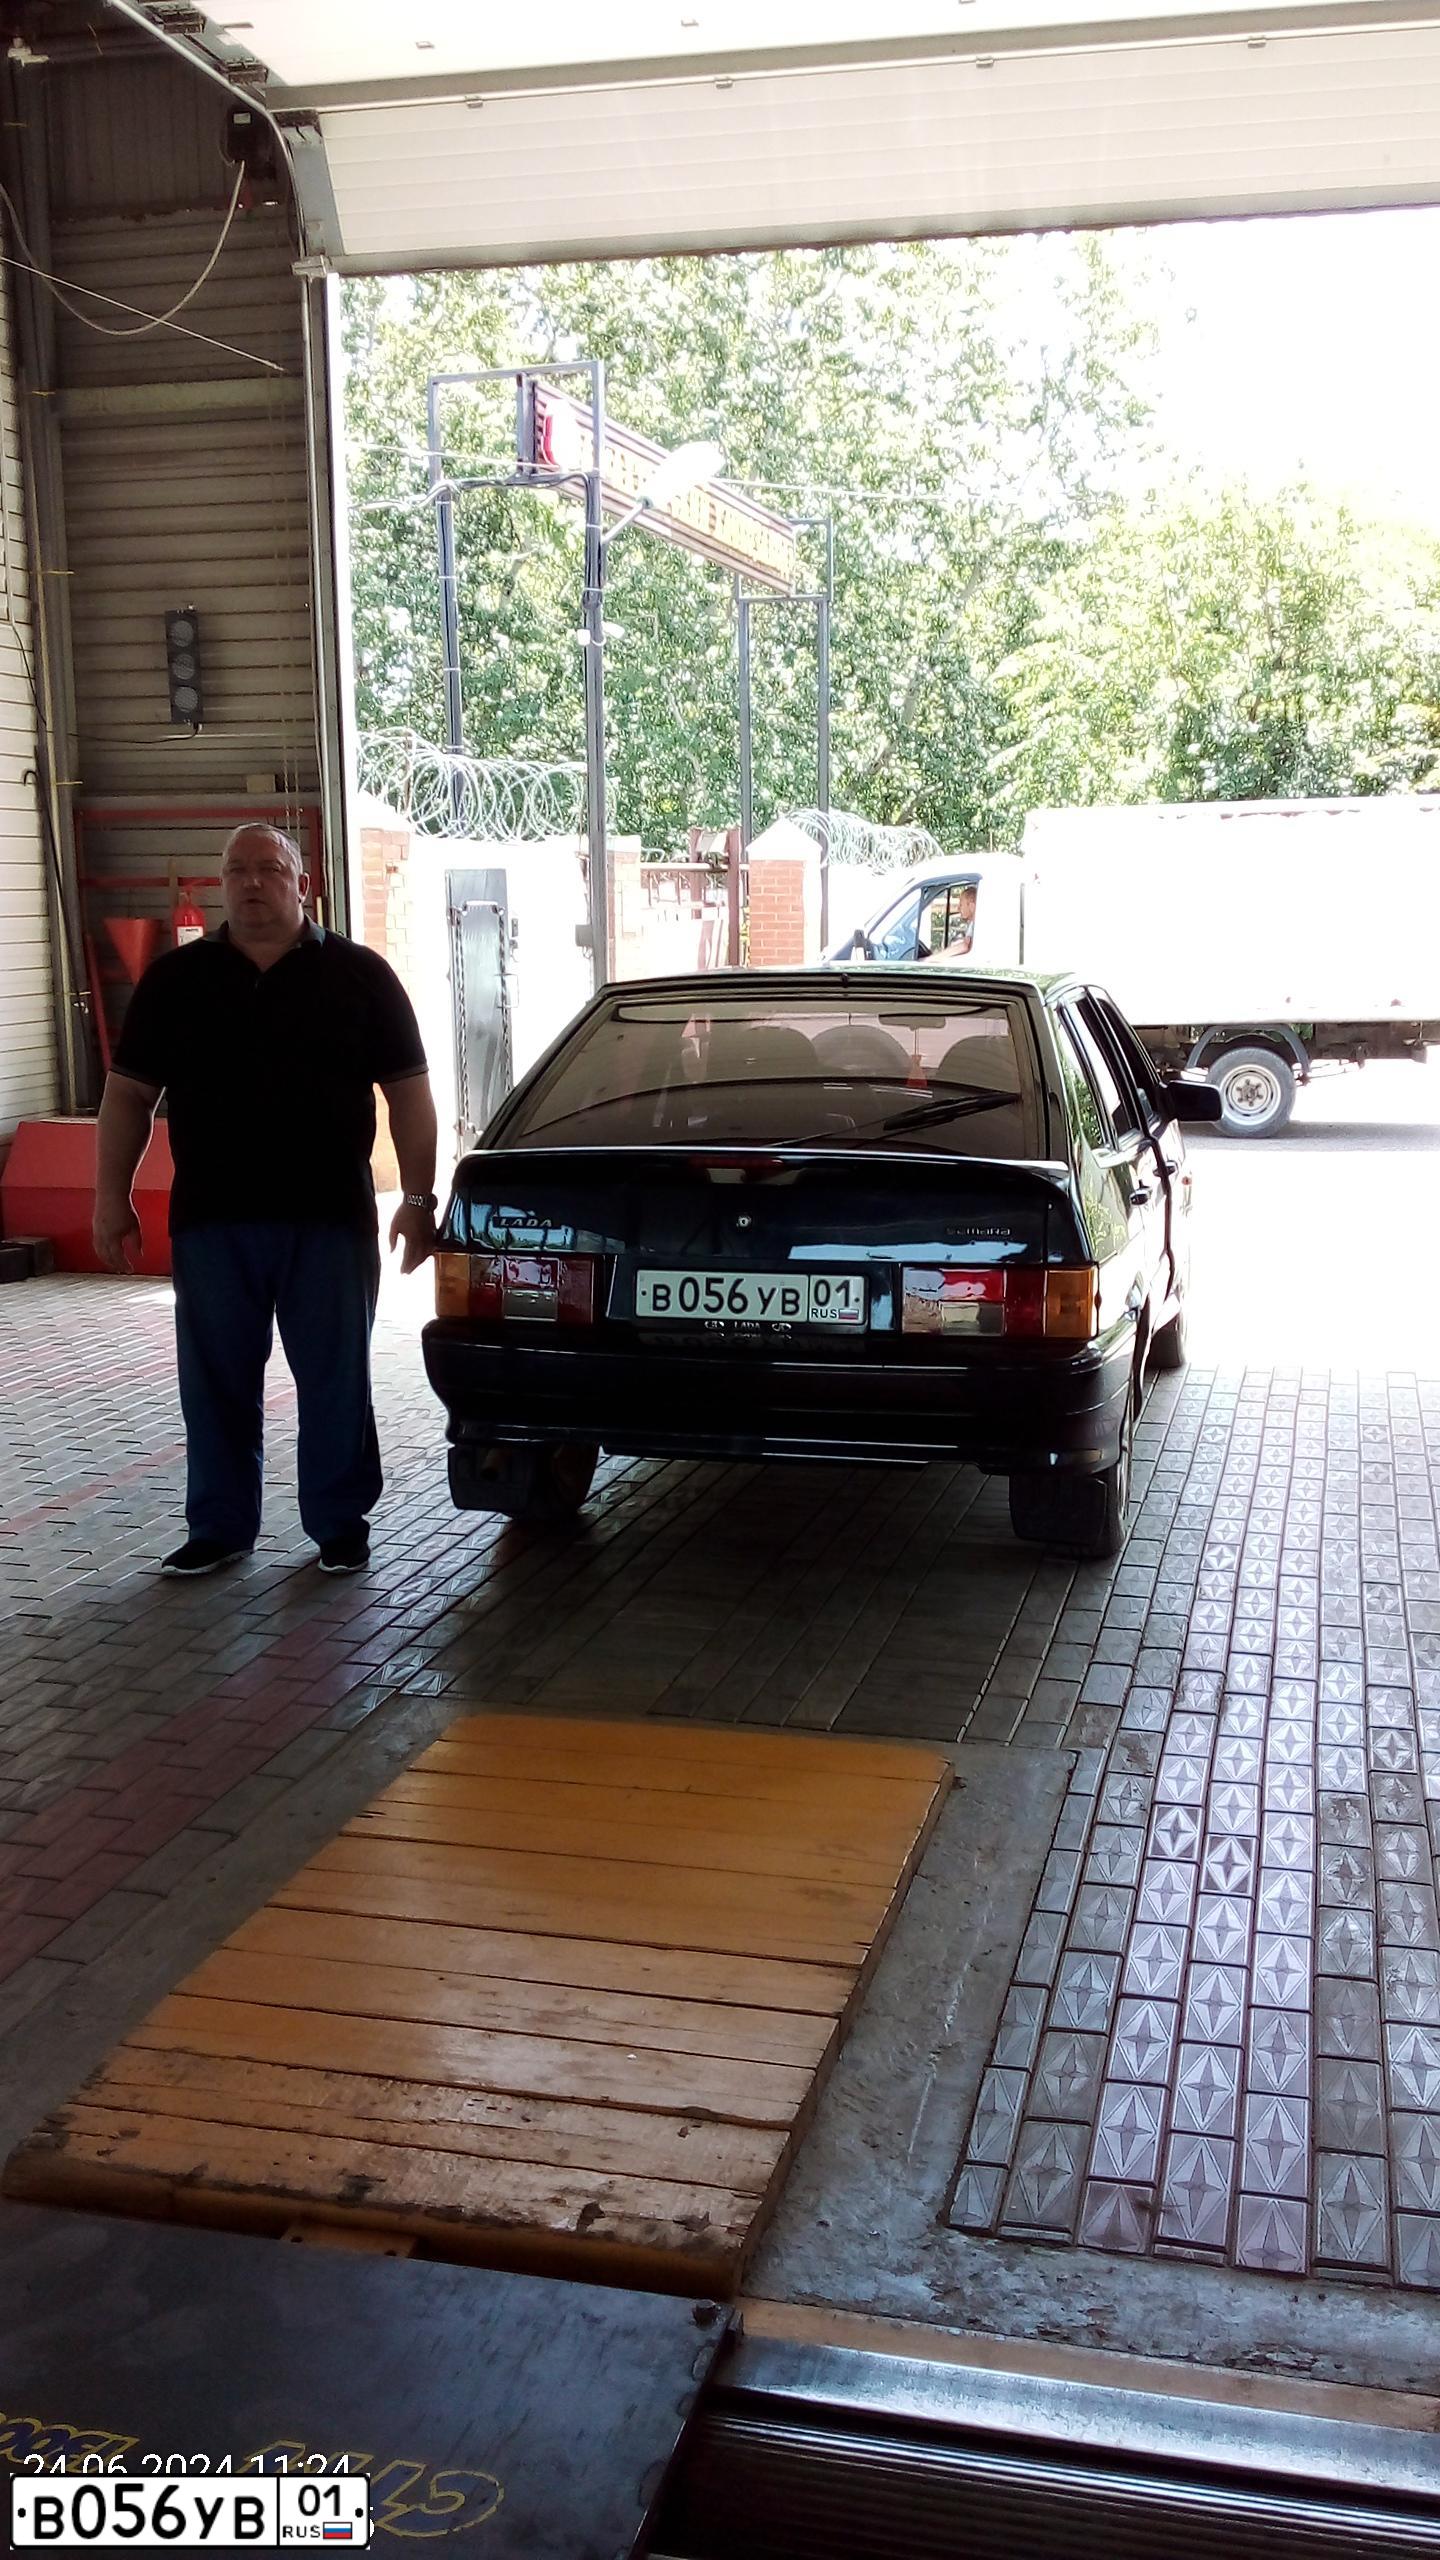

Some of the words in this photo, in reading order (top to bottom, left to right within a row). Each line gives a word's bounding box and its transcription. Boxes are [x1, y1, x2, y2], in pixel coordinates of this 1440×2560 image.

[500, 1218, 553, 1228] LADA
[652, 1276, 801, 1316] В056УВ
[813, 1279, 851, 1308] 01
[811, 1308, 838, 1319] RUS
